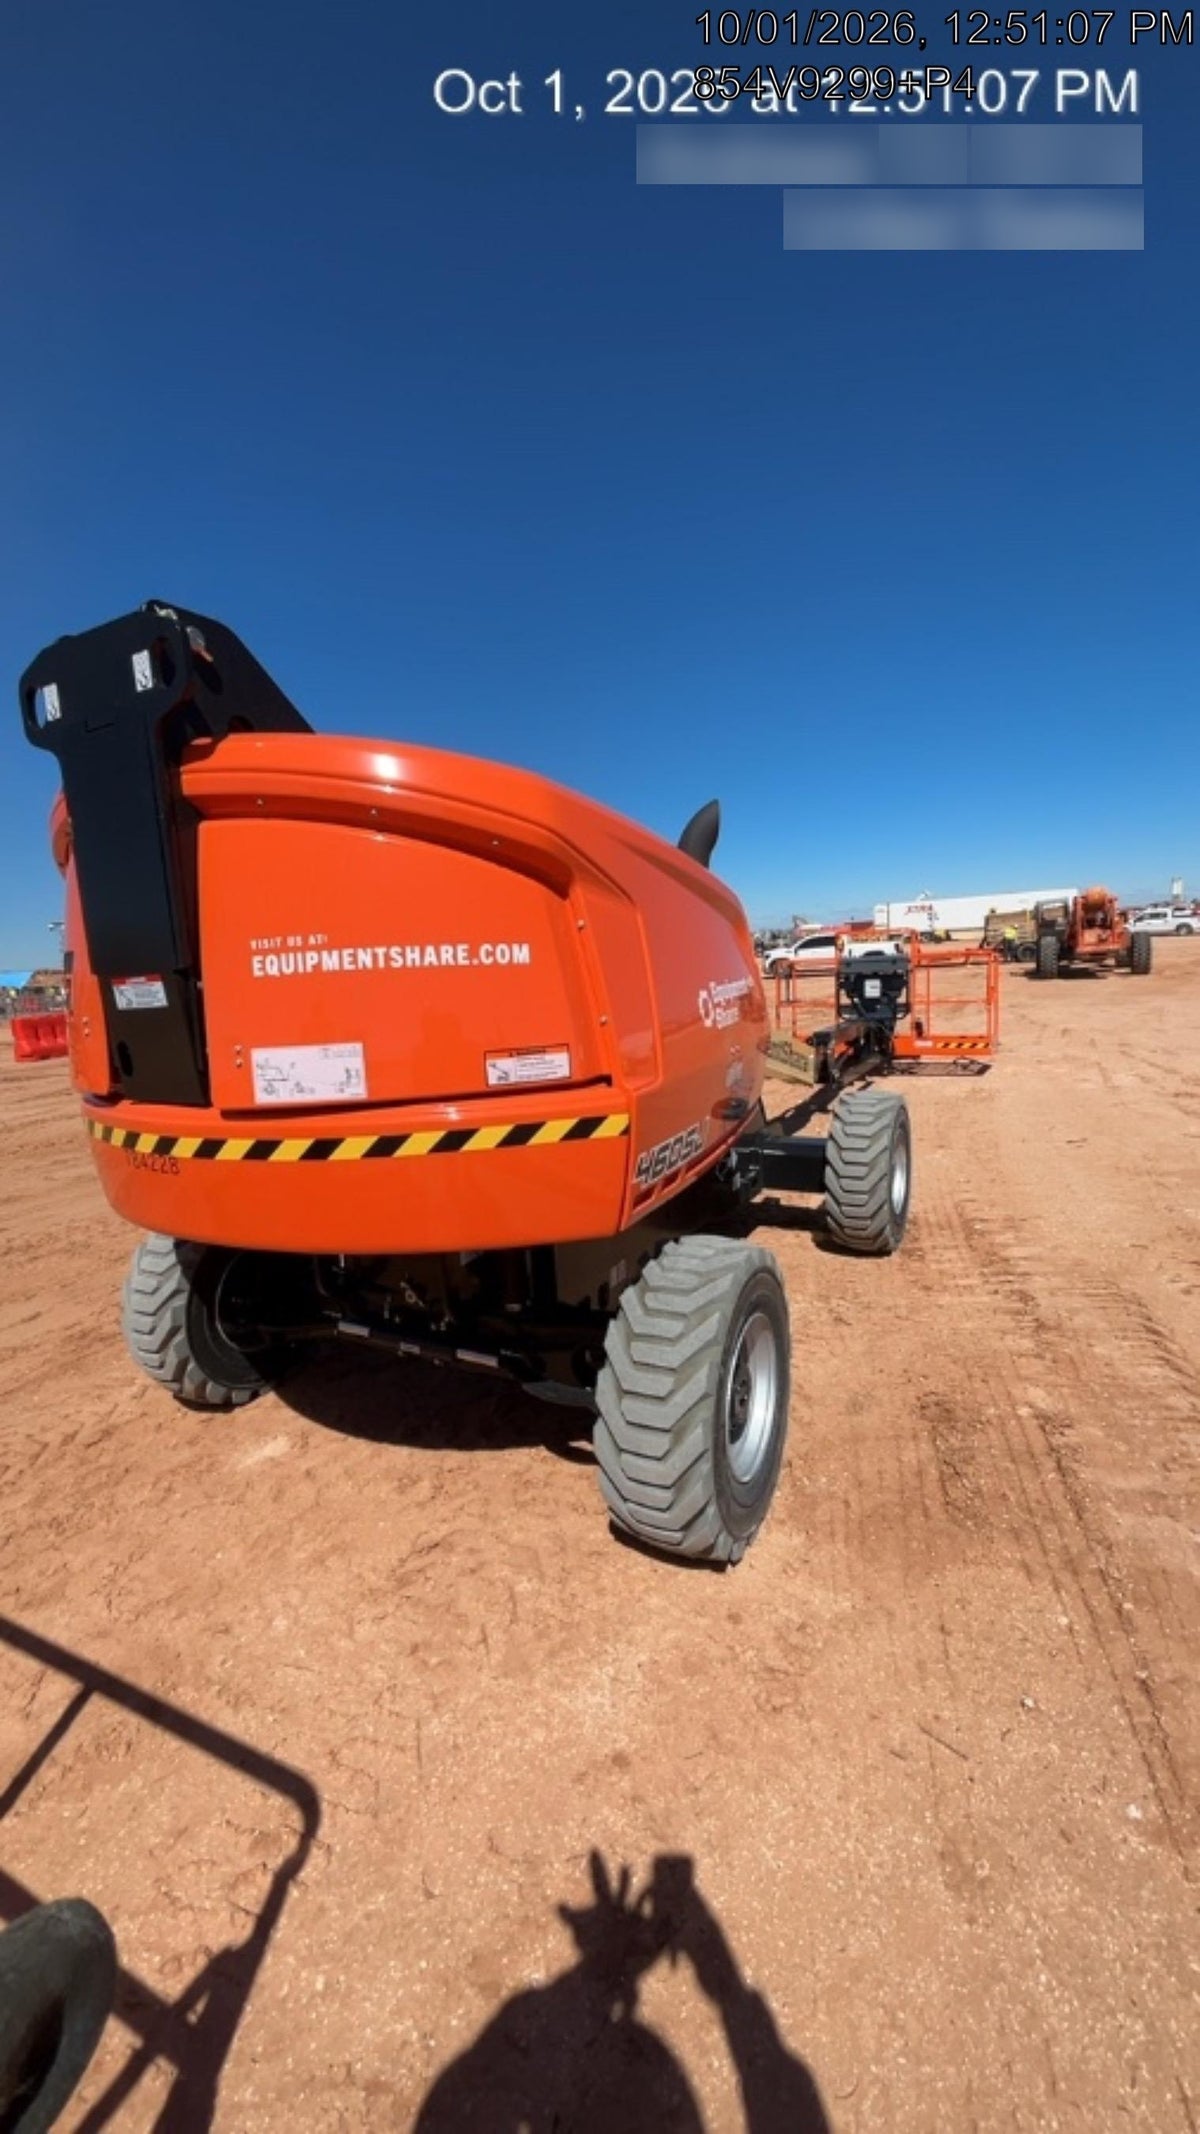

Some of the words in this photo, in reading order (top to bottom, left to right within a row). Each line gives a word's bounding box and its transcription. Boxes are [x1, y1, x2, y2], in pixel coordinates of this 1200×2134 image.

[250, 936, 282, 950] VISIT
[286, 935, 302, 947] US
[251, 942, 531, 978] EQUIPMENTSHARE.COM
